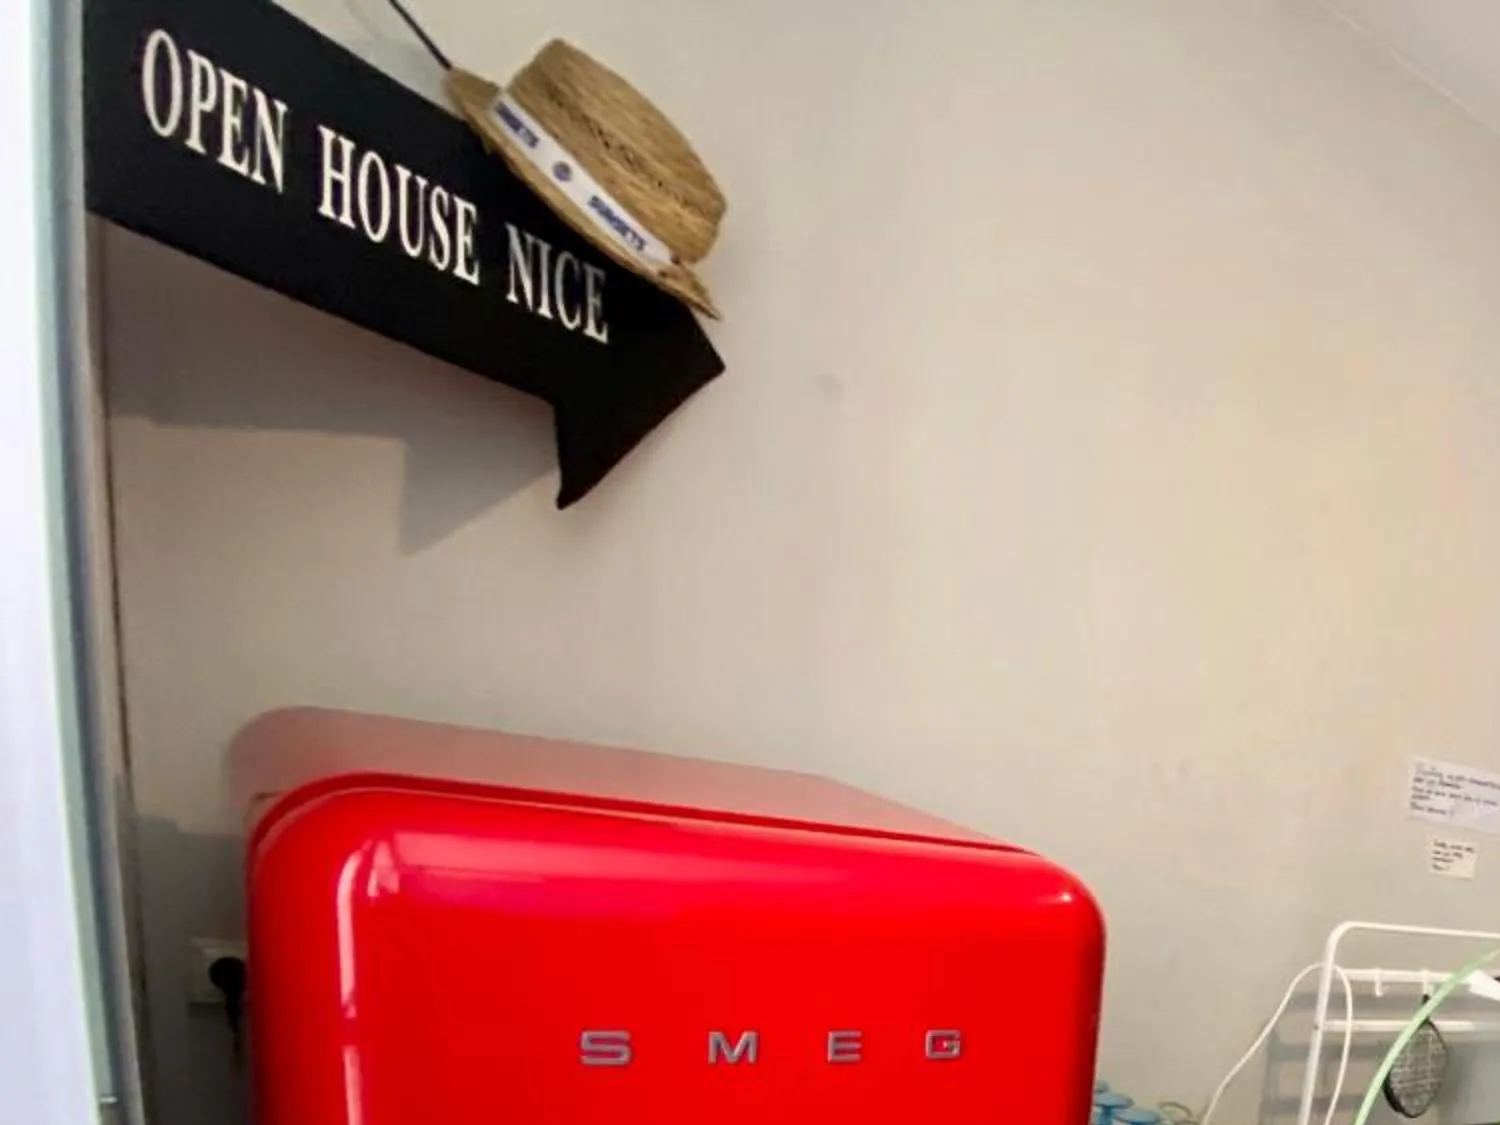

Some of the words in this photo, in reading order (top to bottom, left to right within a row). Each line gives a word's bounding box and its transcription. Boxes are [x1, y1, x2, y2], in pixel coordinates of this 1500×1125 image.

[142, 28, 288, 194] OPEN
[317, 124, 481, 286] HOUSE
[504, 222, 610, 344] NICE
